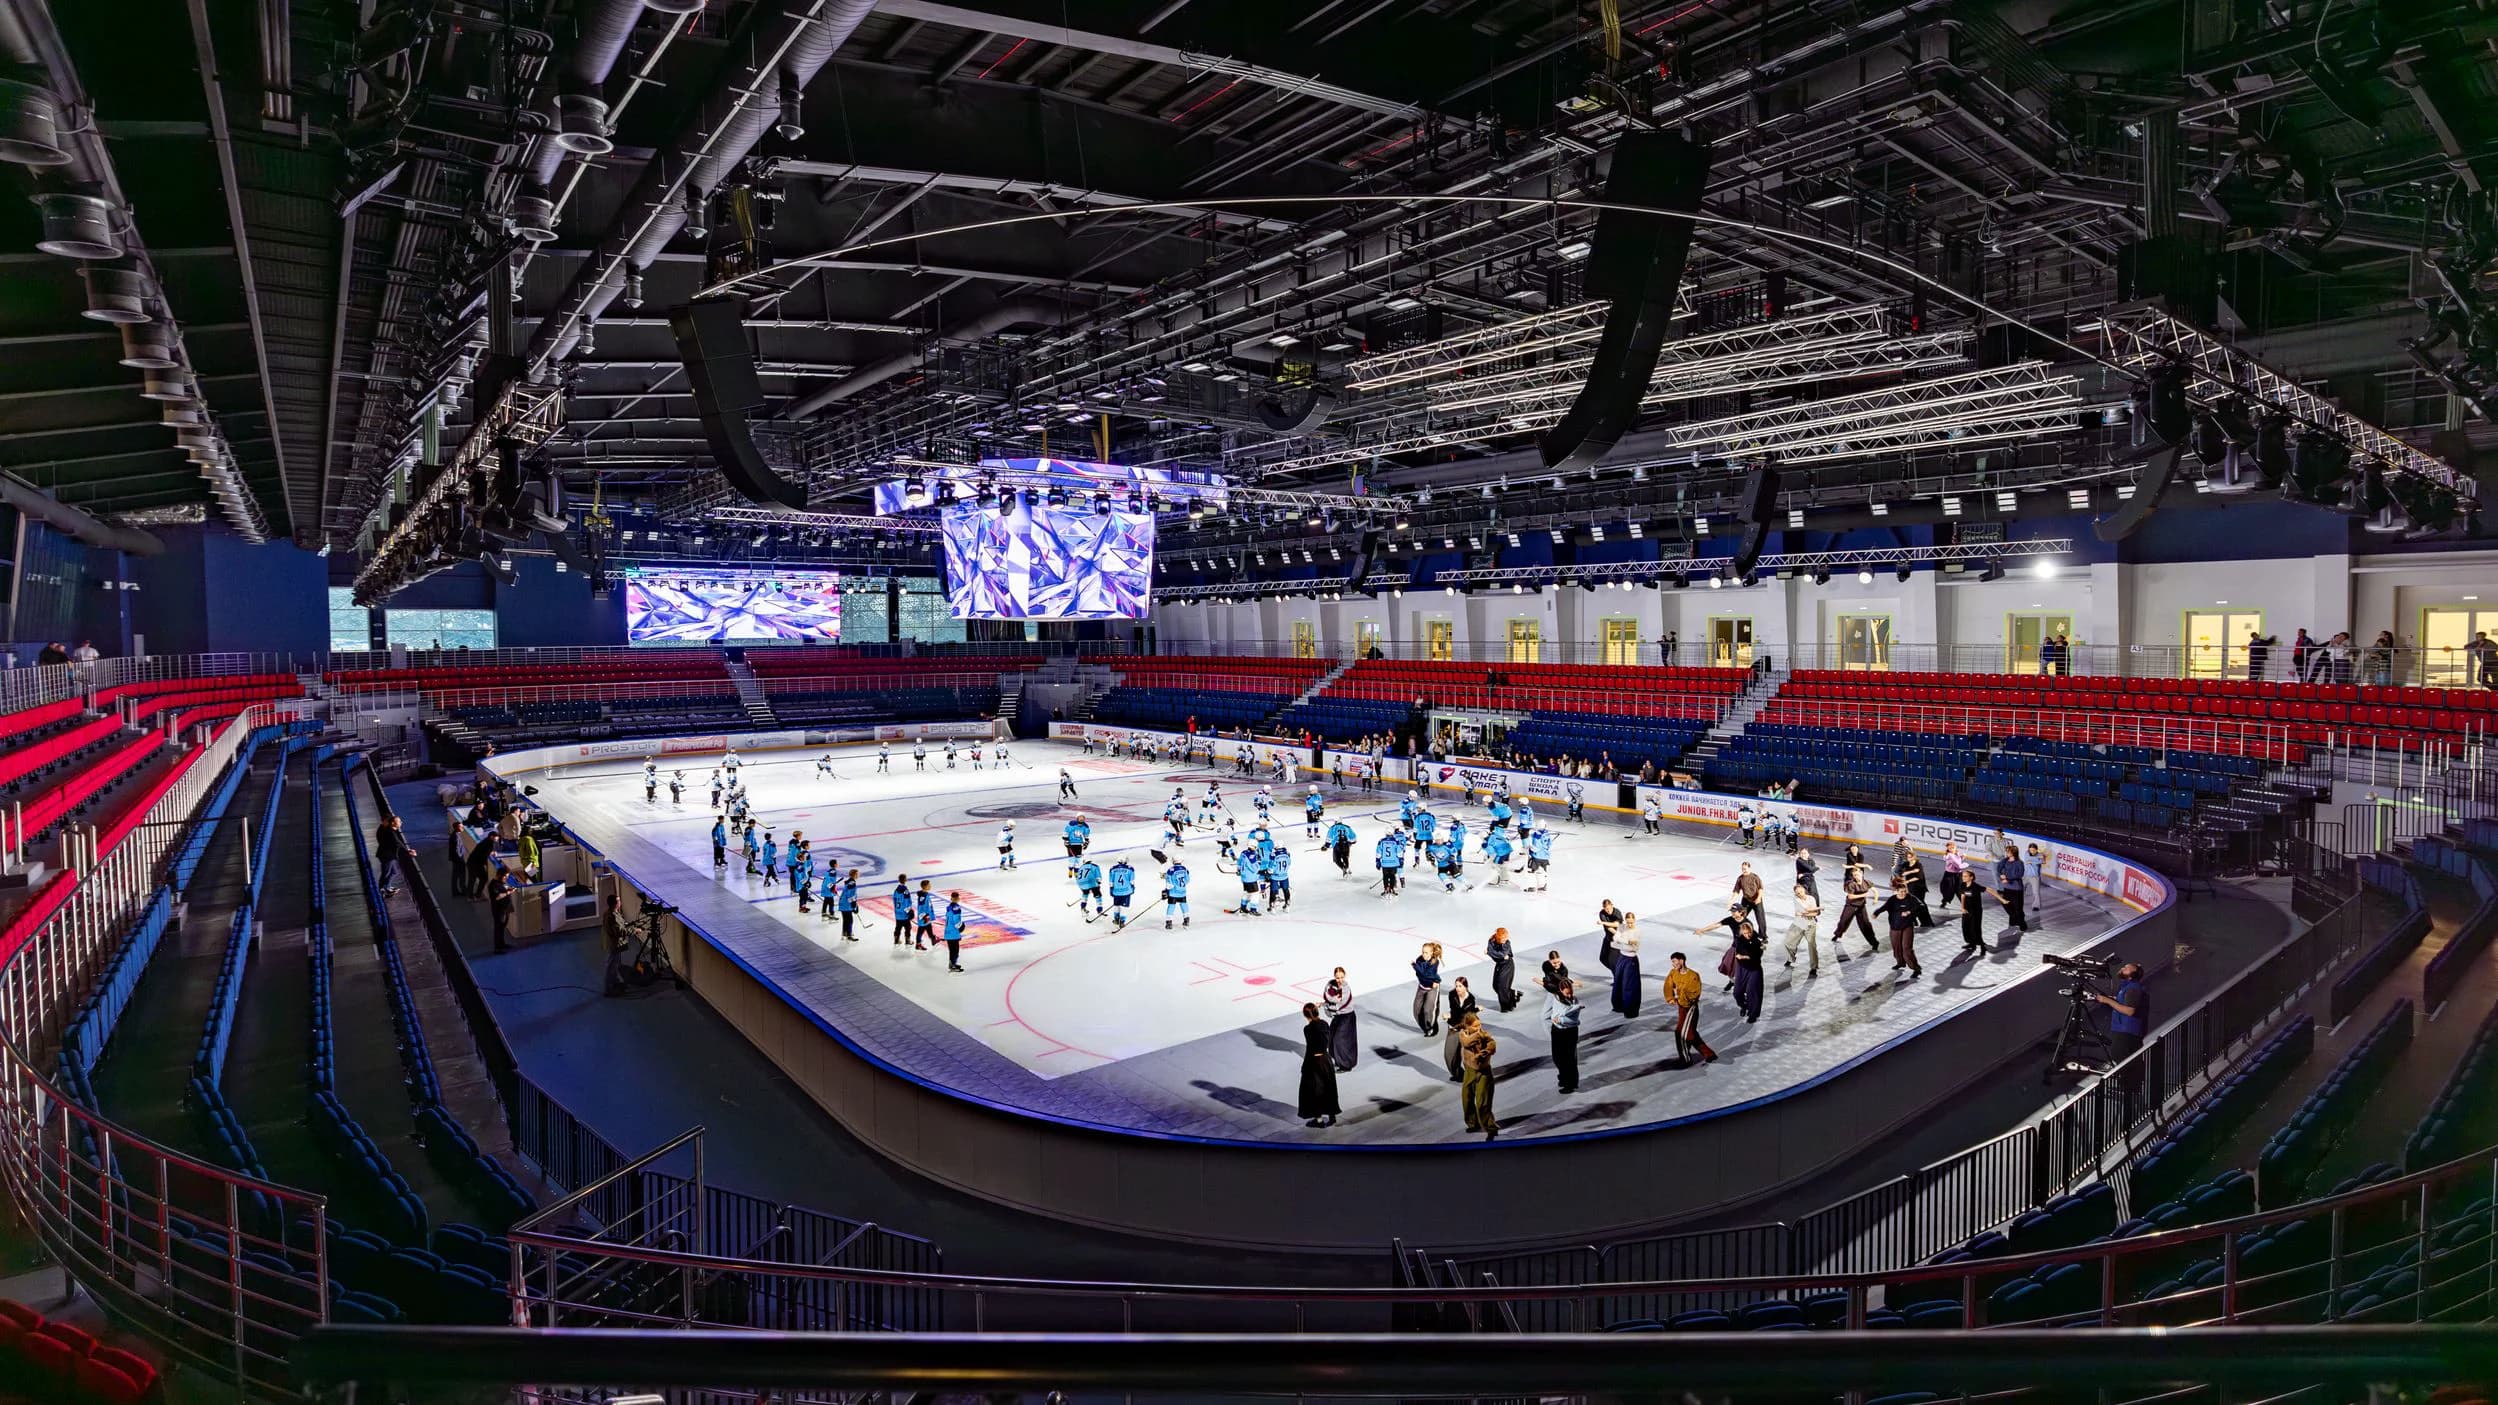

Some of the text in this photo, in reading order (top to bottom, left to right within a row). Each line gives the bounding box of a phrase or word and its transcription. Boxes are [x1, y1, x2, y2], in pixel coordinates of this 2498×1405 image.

[591, 743, 657, 754] PROSTOR
[1530, 776, 1561, 785] СПОРТ
[1528, 788, 1558, 796] ЯМАЛ
[1677, 804, 1739, 820] JUNIOR.FHR.RU
[1420, 820, 1431, 831] 12
[1385, 846, 1391, 858] 5
[2056, 852, 2097, 869] ФЕДЕРАЦИЯ
[2057, 862, 2085, 876] ХОККЕЯ
[1117, 874, 1124, 886] 4
